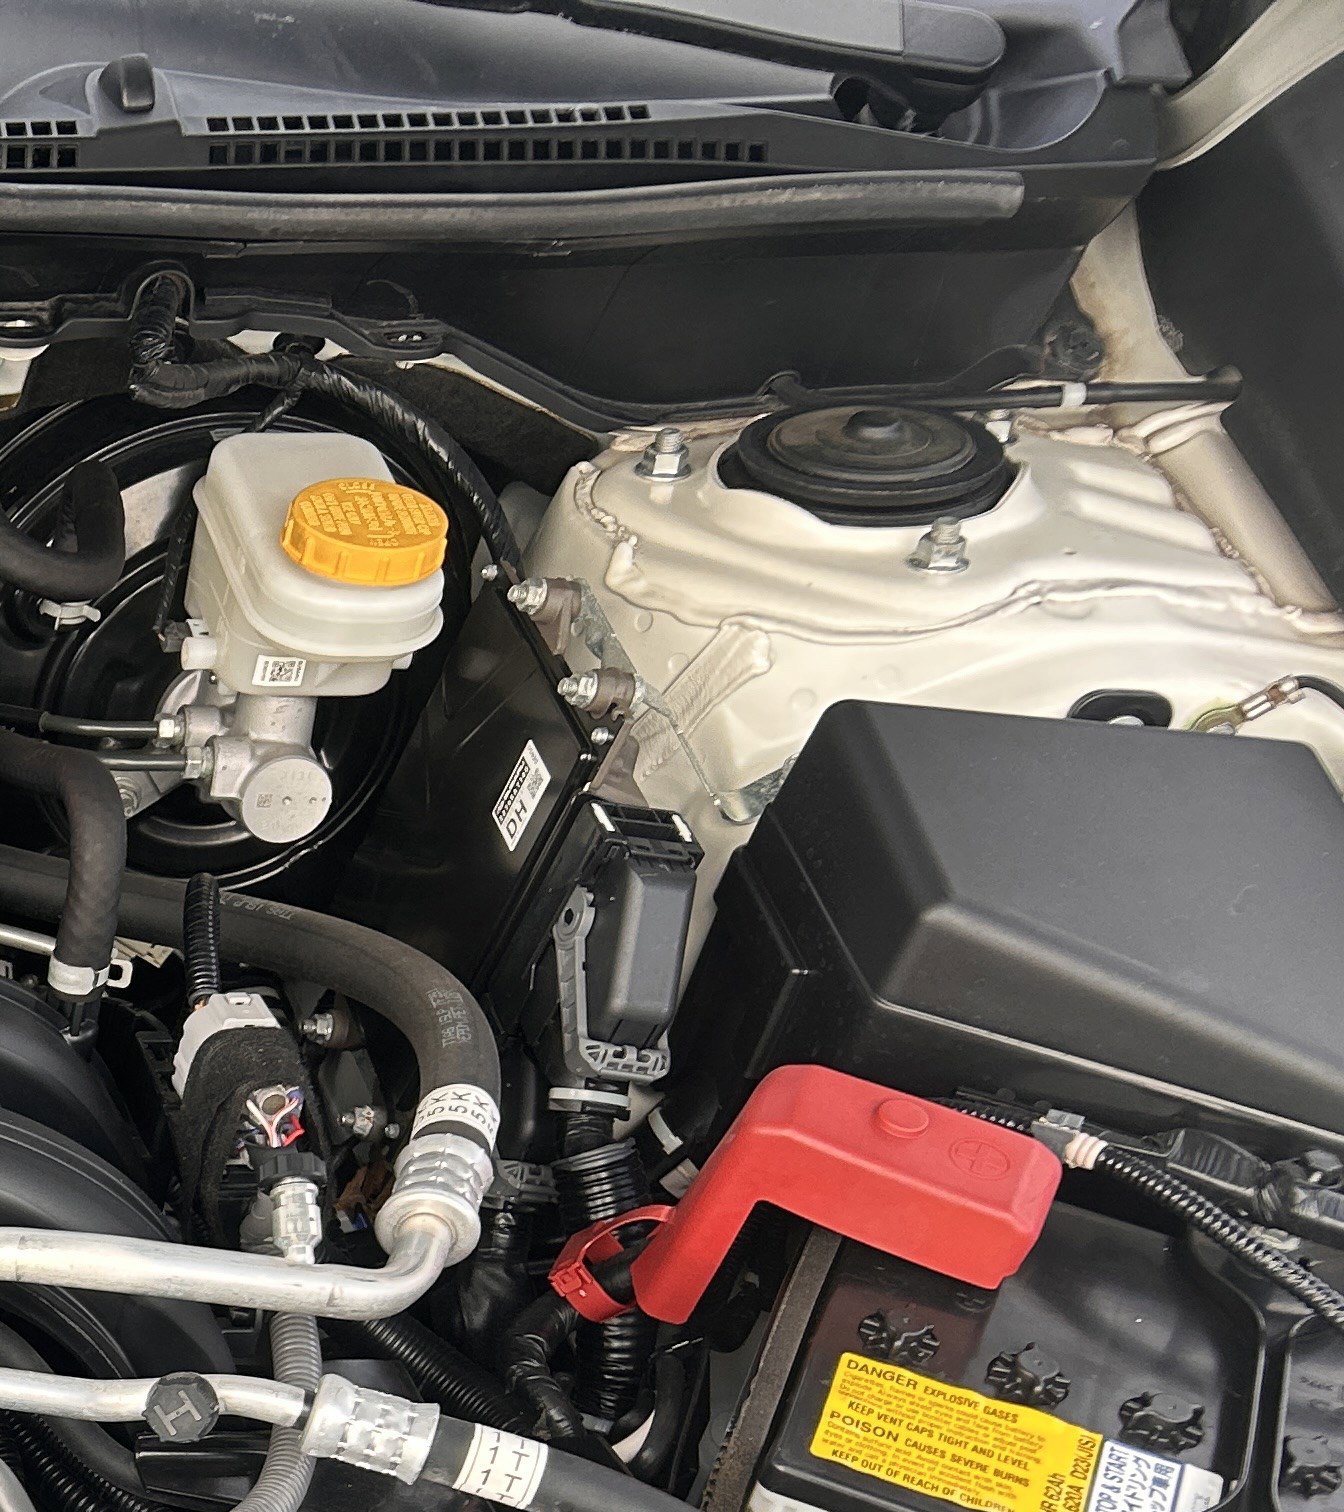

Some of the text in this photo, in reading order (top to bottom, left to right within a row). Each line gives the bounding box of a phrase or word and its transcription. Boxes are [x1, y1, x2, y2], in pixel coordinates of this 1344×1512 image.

[845, 1358, 1018, 1424] DANGER EXPLOSIVE GASES
[828, 1410, 1030, 1487] POISON CAUSES SEVERE BURNS
[846, 1400, 1030, 1471] KEEP VENT CAPS TIGHT AND LEVEL
[1103, 1446, 1130, 1484] START
[831, 1448, 858, 1464] KEEP
[860, 1458, 883, 1473] OUT
[885, 1467, 900, 1479] OF
[902, 1473, 939, 1492] REACH
[941, 1486, 956, 1498] OF
